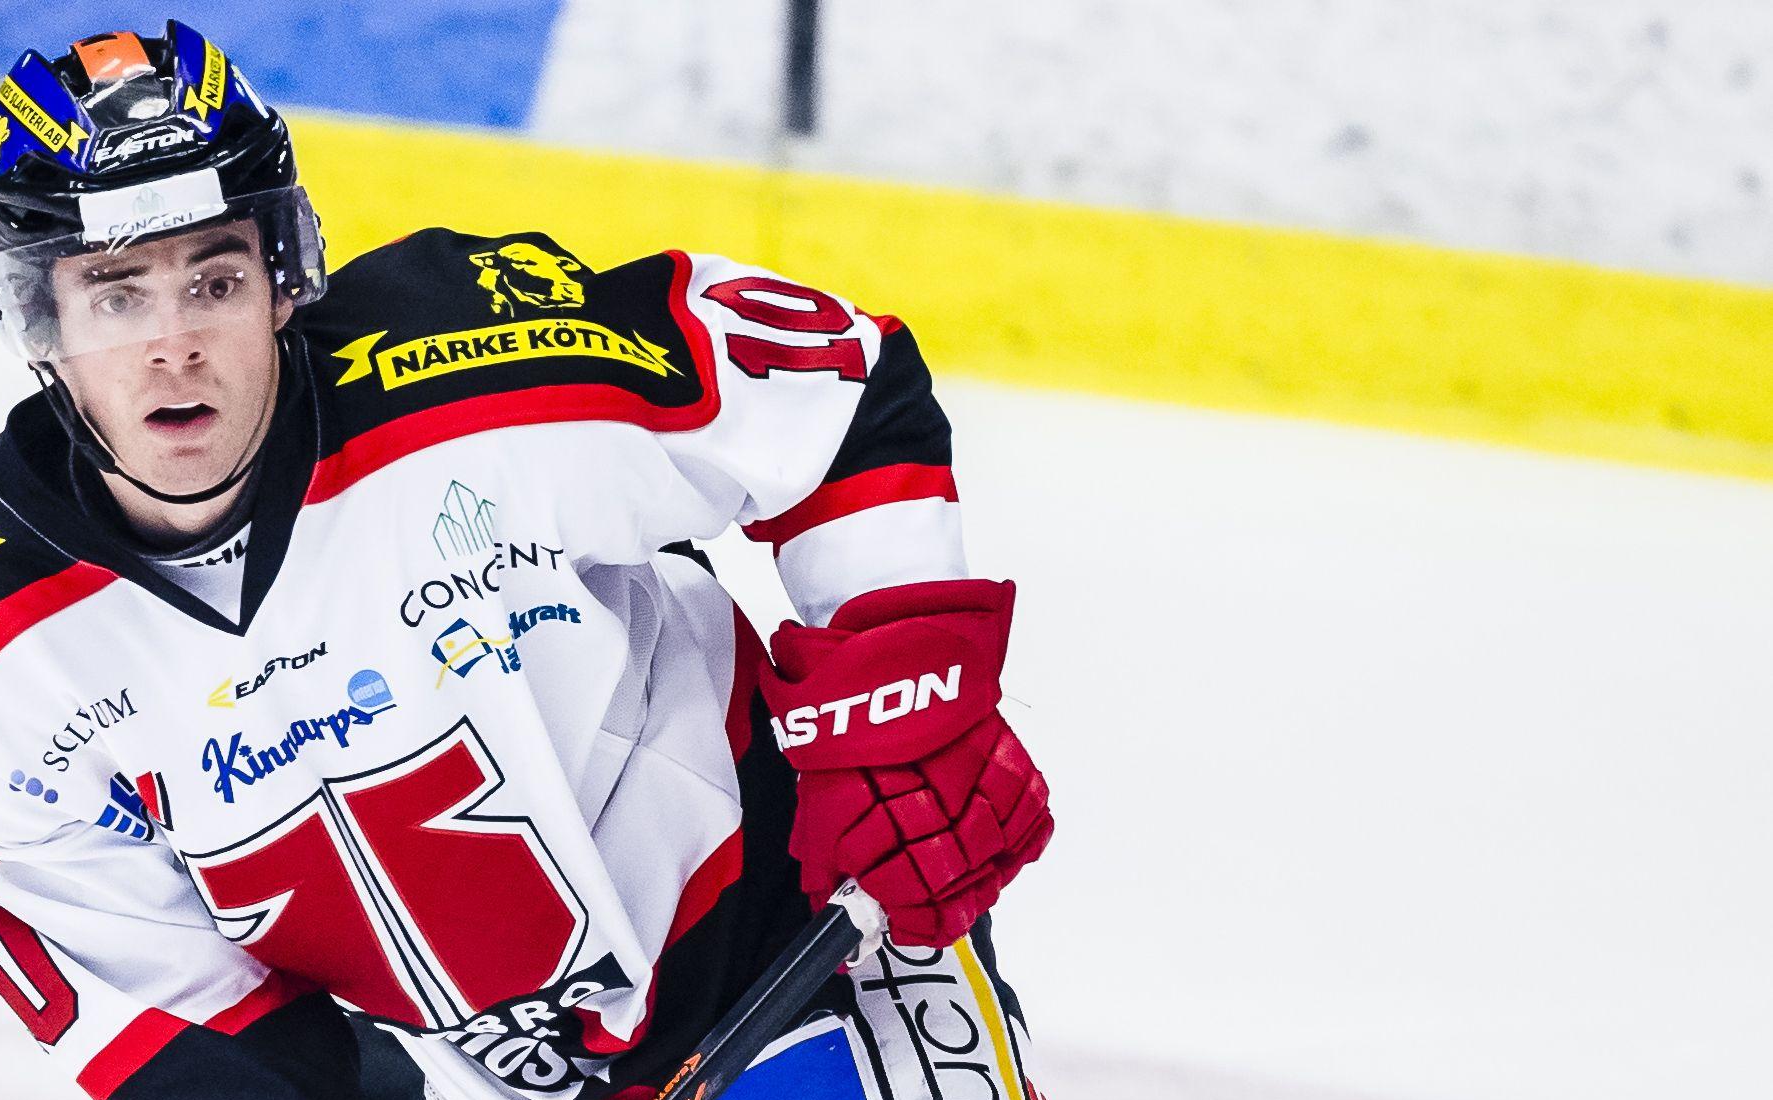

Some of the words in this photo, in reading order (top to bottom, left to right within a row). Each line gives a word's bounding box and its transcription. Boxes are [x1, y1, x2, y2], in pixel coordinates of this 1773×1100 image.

[8, 92, 48, 132] SLAKTERI
[44, 127, 64, 146] AB
[94, 129, 195, 167] EASTON
[391, 330, 520, 378] NÄRKE
[527, 321, 610, 351] KÖTT
[700, 276, 868, 384] 10
[235, 641, 328, 699] EASTON
[202, 703, 398, 803] Kinnarps
